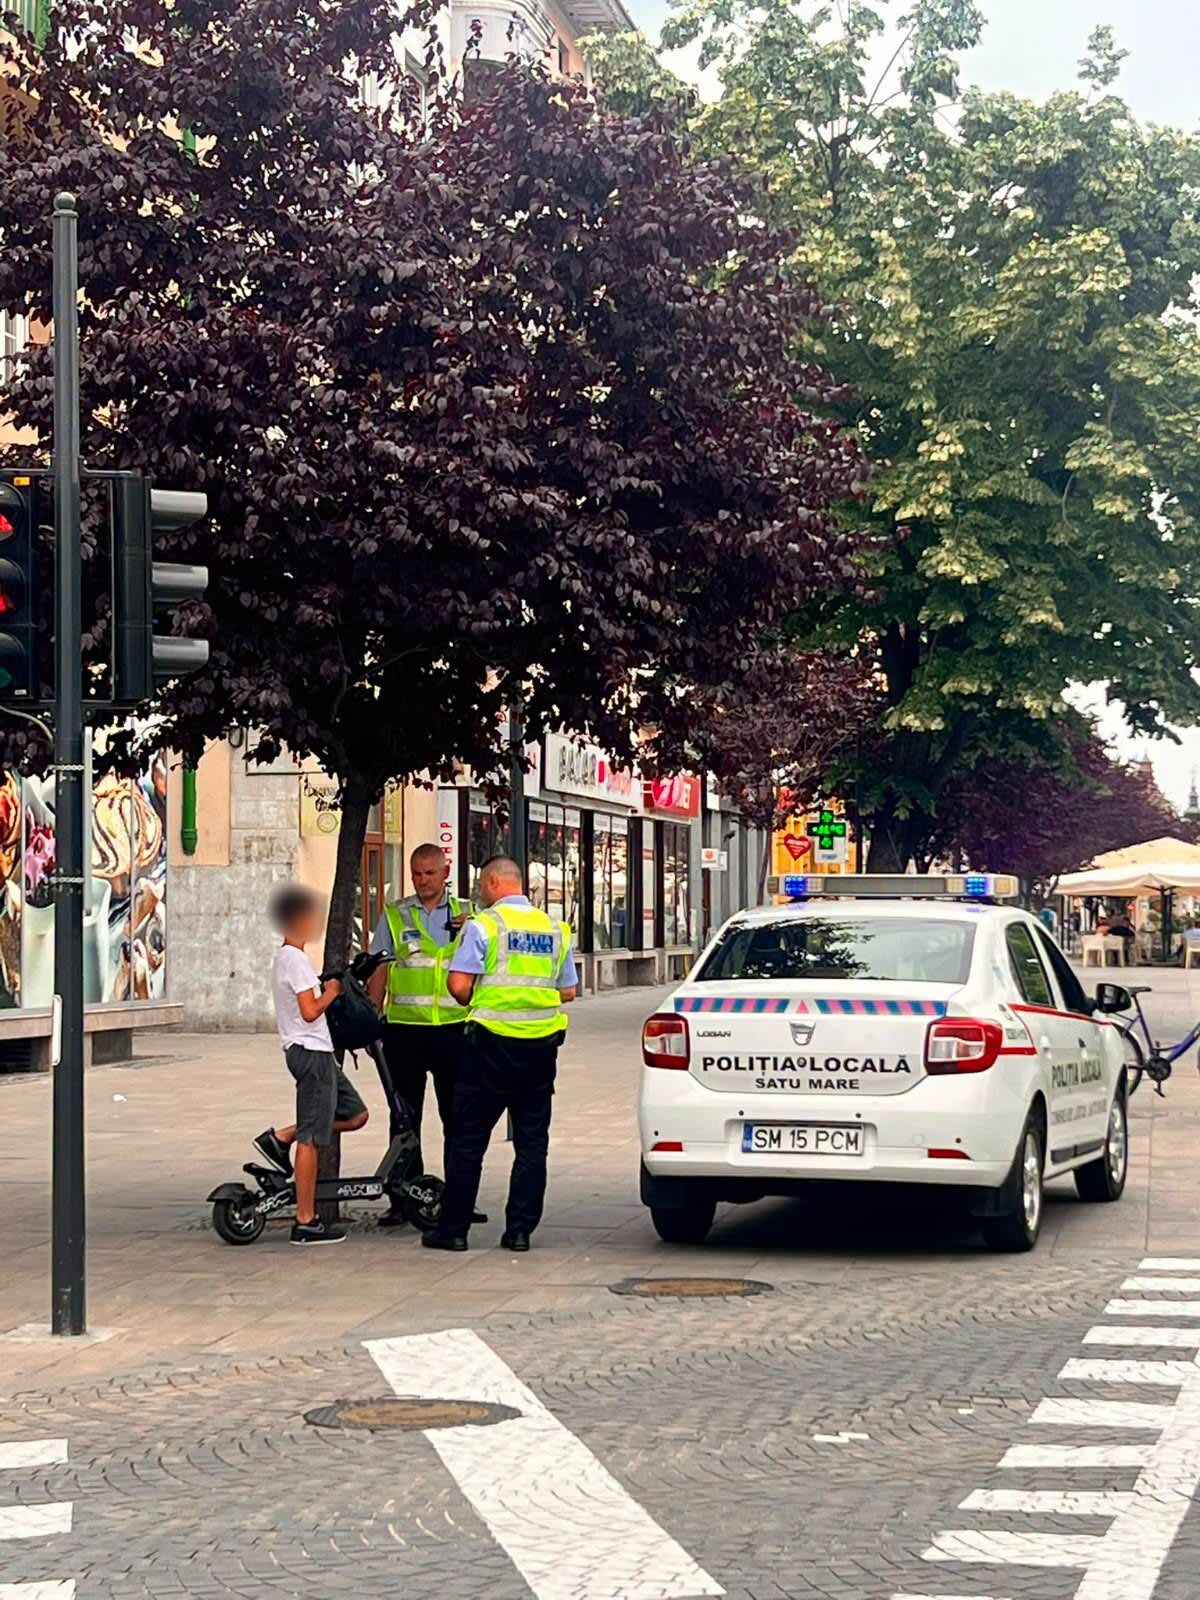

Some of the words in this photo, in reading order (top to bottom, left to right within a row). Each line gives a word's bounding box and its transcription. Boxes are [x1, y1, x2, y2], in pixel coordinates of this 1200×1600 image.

[809, 1055, 911, 1073] LOCALĂ
[755, 1078, 801, 1089] SATU
[808, 1079, 860, 1090] MARE
[754, 1129, 782, 1149] SM
[789, 1130, 808, 1149] 15
[815, 1130, 859, 1151] PCM
